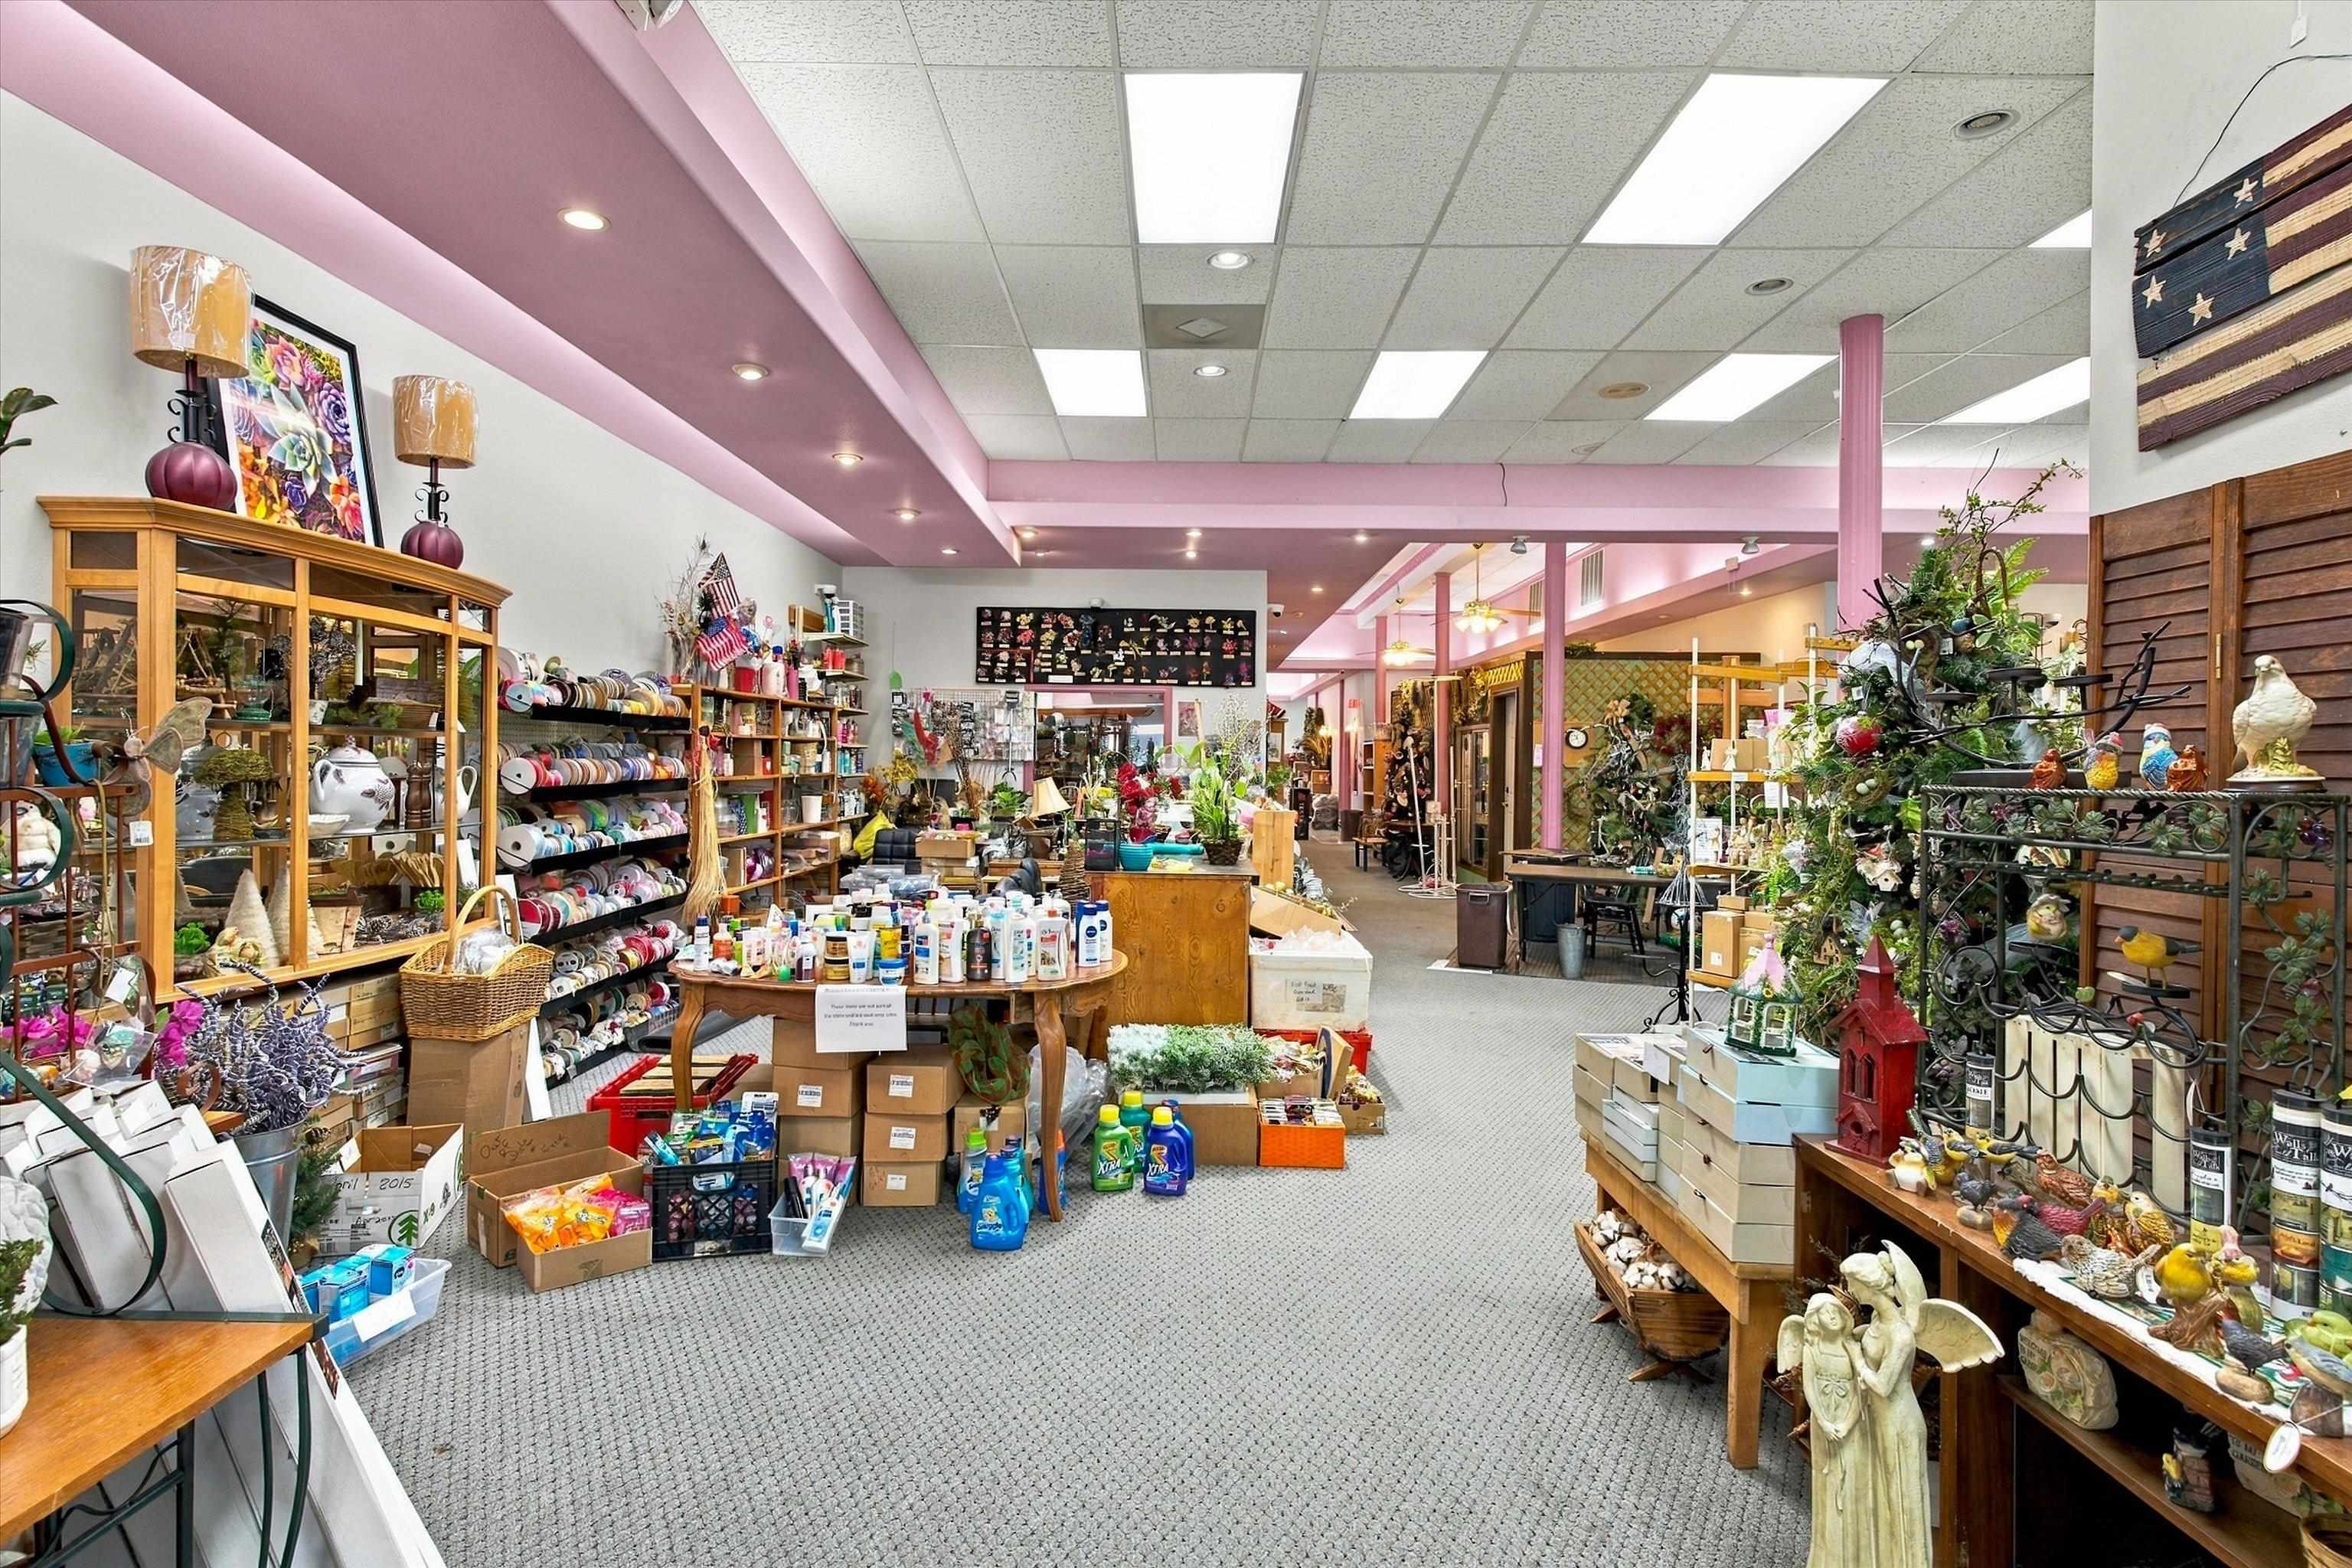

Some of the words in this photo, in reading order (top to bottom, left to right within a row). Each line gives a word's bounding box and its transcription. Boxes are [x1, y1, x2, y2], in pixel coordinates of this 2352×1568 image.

[1097, 1158, 1121, 1175] XTRA
[1148, 1163, 1168, 1178] XTRA
[380, 1178, 414, 1190] 2015
